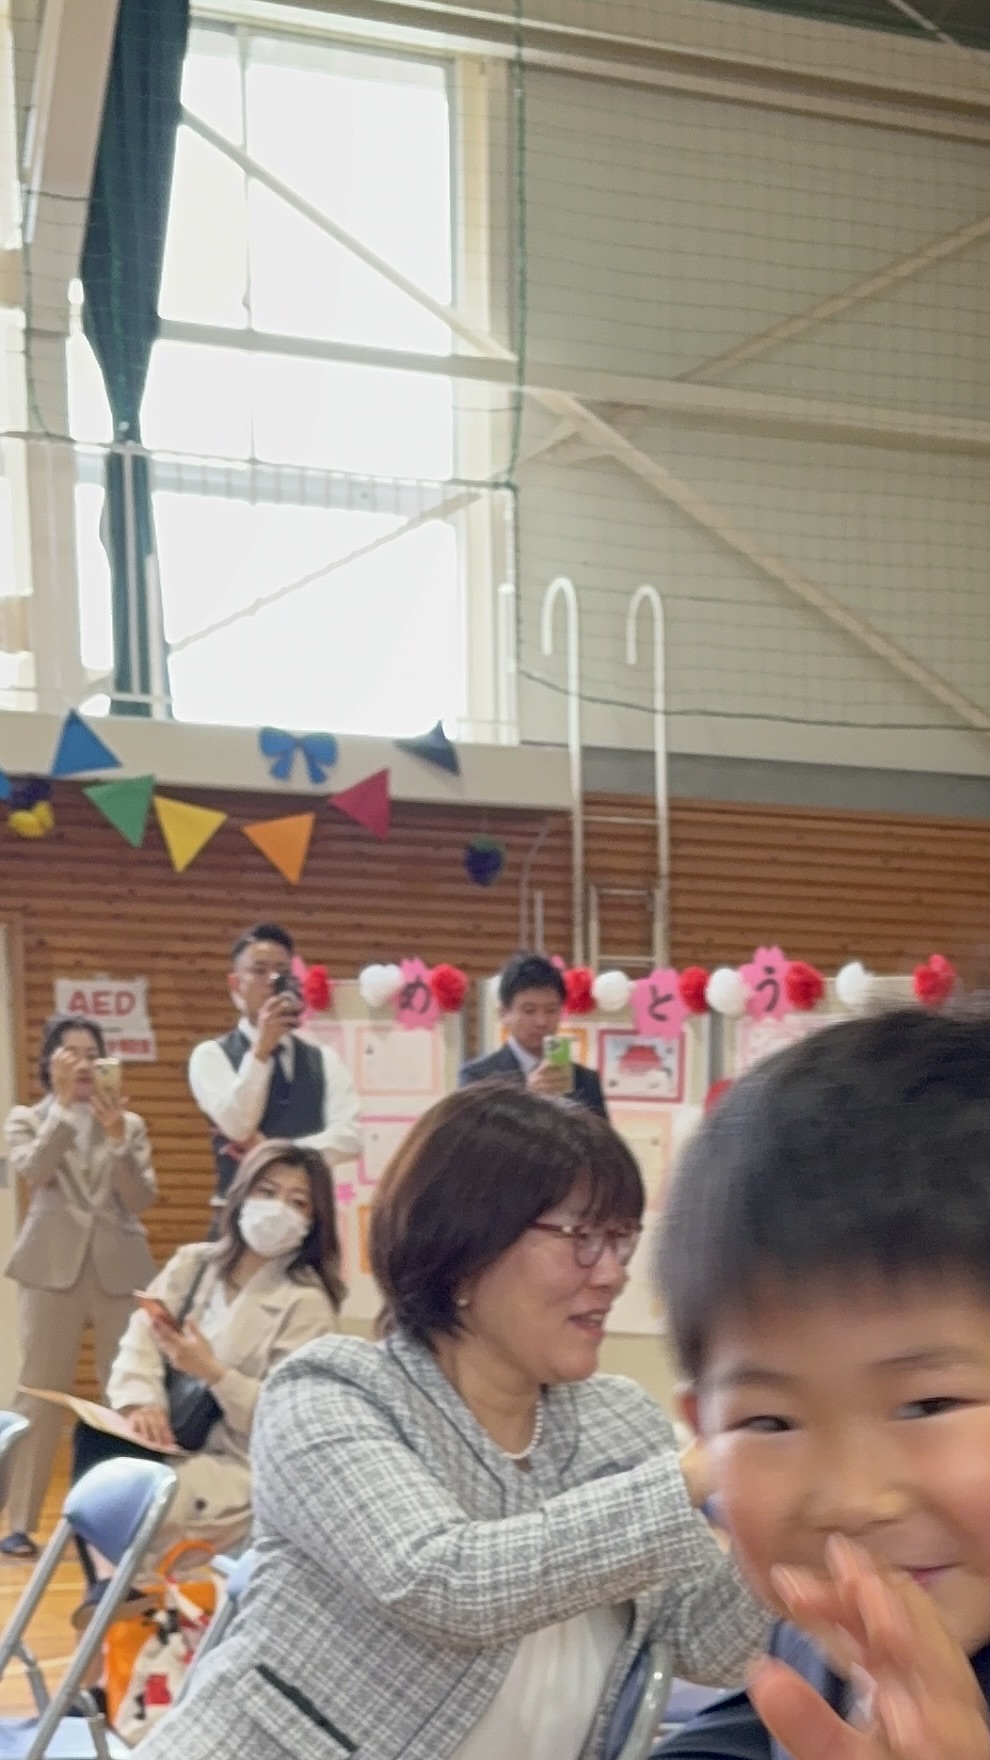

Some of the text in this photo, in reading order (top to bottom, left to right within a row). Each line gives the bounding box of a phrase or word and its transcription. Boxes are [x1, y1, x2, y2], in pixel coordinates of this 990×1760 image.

[68, 990, 136, 1016] AED
[401, 966, 779, 1021] め と う
